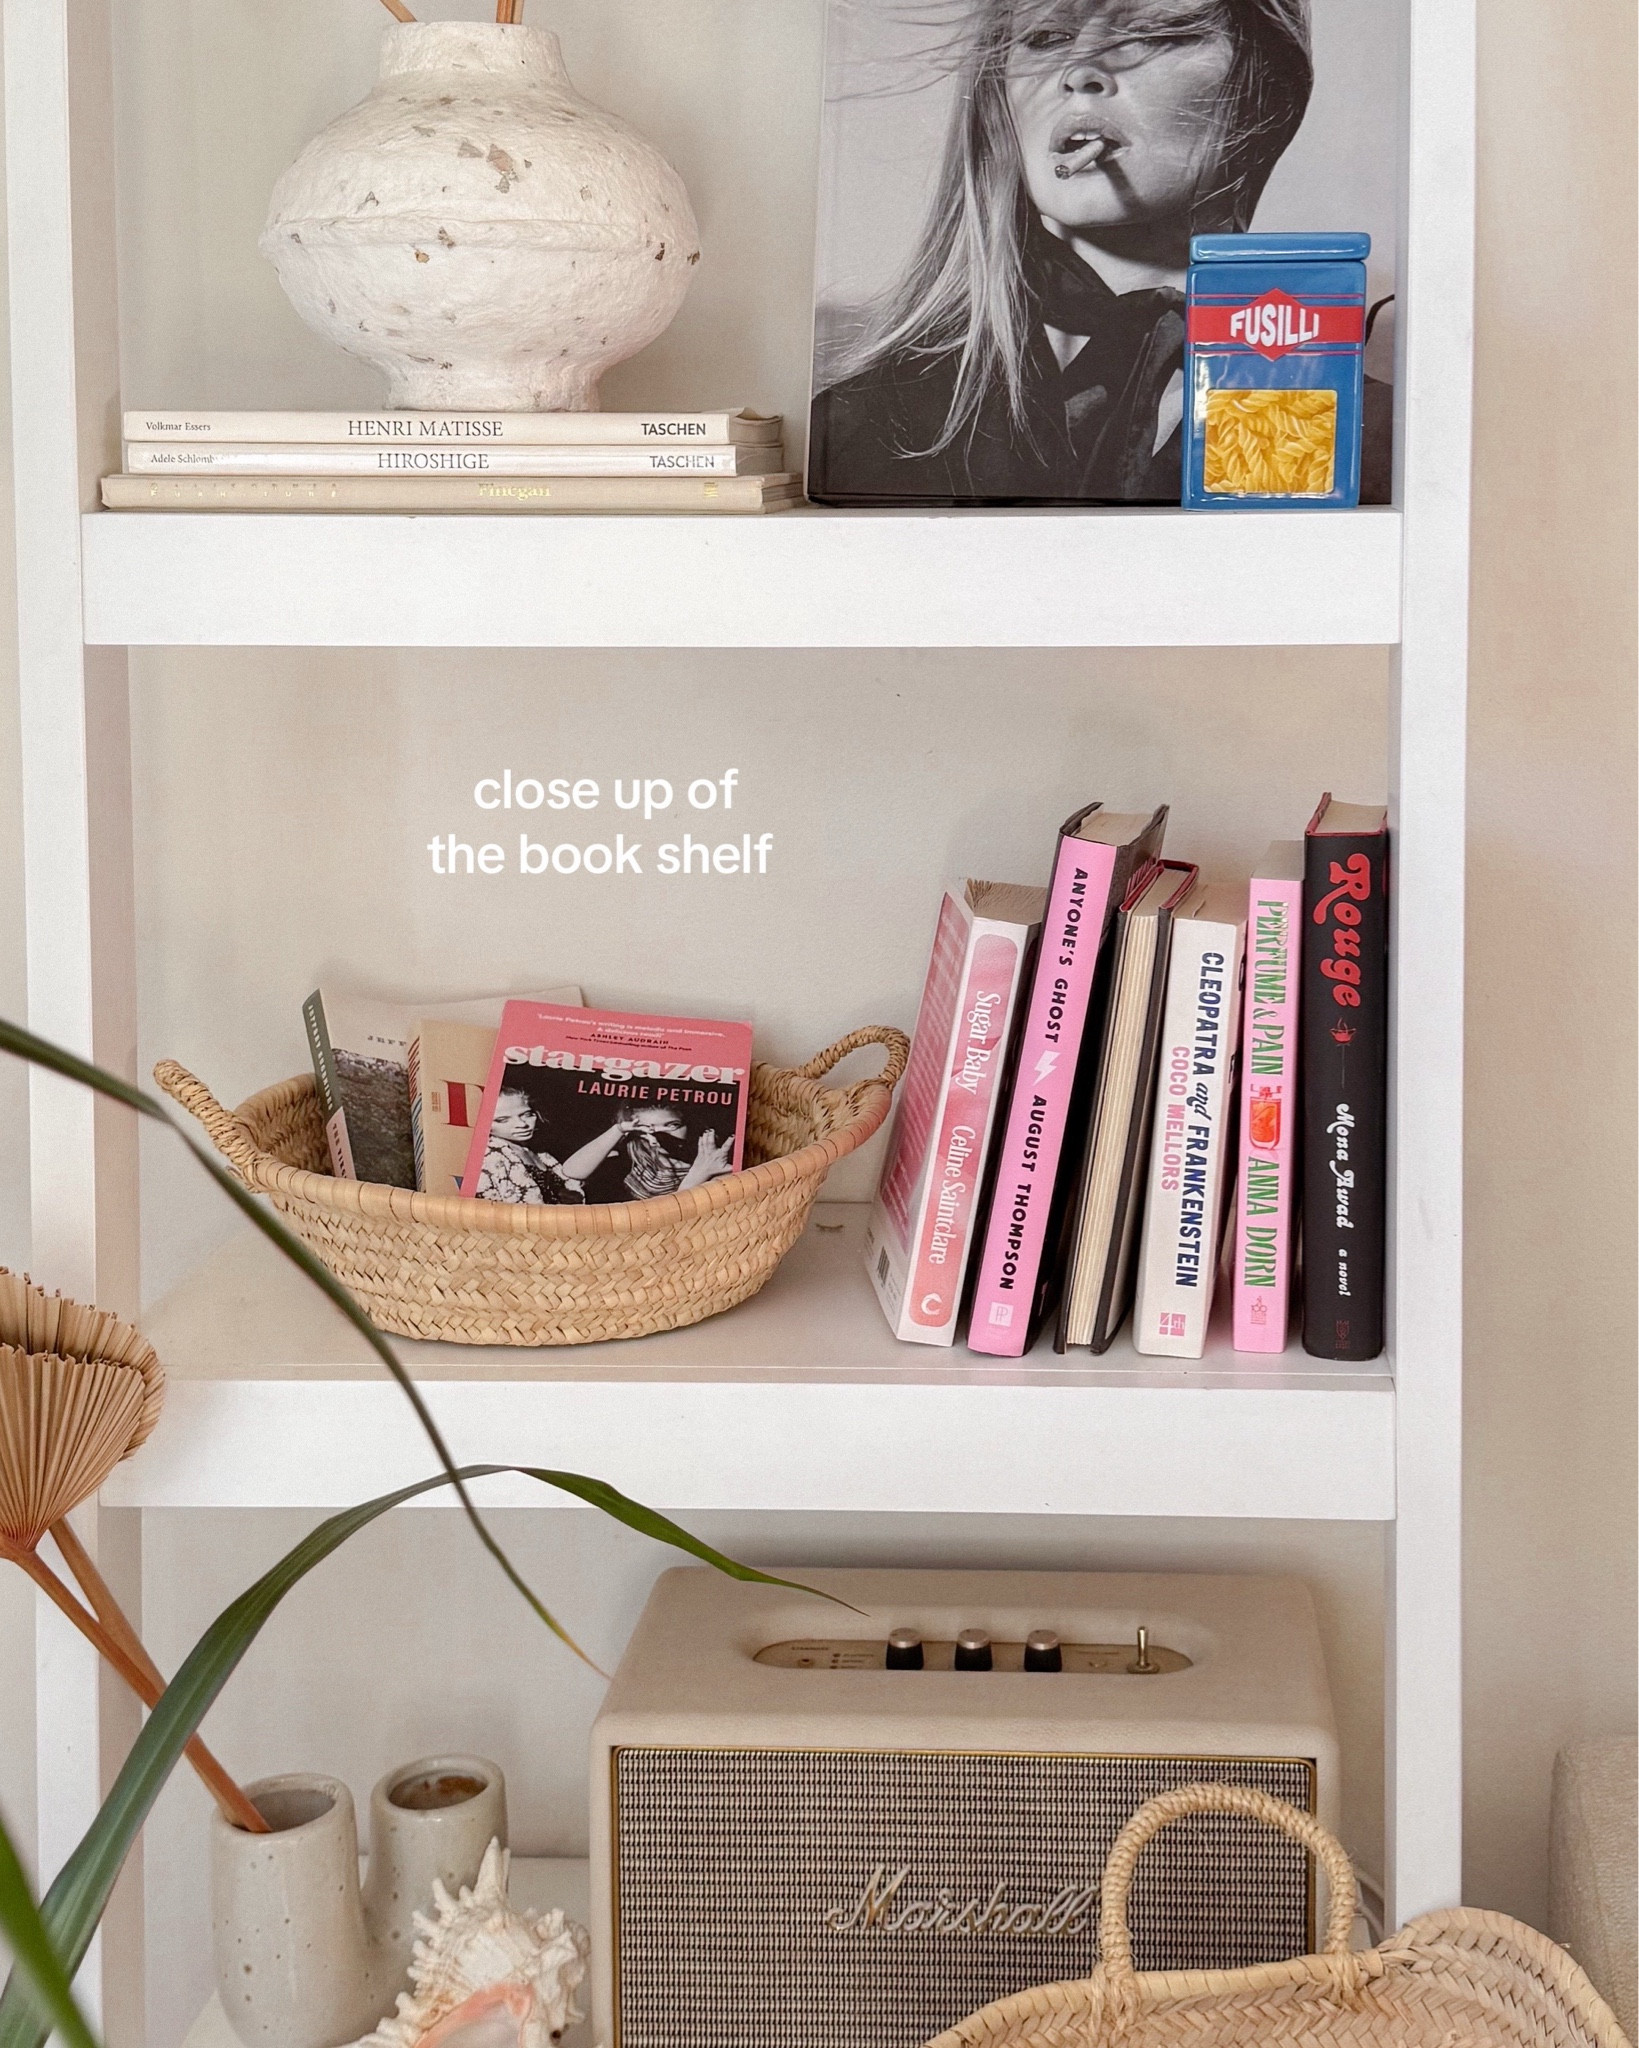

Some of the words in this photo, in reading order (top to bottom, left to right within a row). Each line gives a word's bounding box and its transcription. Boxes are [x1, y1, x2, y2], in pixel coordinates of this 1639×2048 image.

[230, 303, 320, 347] FUSILLI
[146, 421, 182, 431] Volkmar
[185, 422, 211, 431] Essers
[348, 420, 412, 436] HENRI
[418, 420, 503, 437] MATISSE
[641, 422, 706, 436] TASCHEN
[151, 453, 176, 464] Adele
[377, 453, 489, 469] HIROSHIGE
[649, 455, 715, 468] TASCHEN
[1058, 867, 1089, 966] ANYONE'S
[1313, 853, 1371, 1007] Rouge
[1254, 900, 1289, 1005] PERFUME
[1045, 978, 1068, 1043] GHOST
[1192, 952, 1225, 1075] CLEOPATRA
[1253, 1007, 1279, 1020] &
[503, 1045, 746, 1085] stargazer
[955, 1046, 992, 1095] Baby
[1168, 1046, 1190, 1096] COCO
[1251, 1023, 1285, 1076] PAIN
[577, 1080, 649, 1100] LAURIE
[656, 1087, 733, 1106] PETROU
[1186, 1082, 1213, 1121] and
[944, 1125, 976, 1178] Celine
[1021, 1094, 1047, 1172] AUGUST
[1161, 1104, 1186, 1191] MELLORS
[1326, 1103, 1356, 1161] Mona
[1175, 1125, 1210, 1287] FRANKENSTEIN
[1246, 1156, 1280, 1216] ANNA
[1328, 1160, 1355, 1229] Awad
[928, 1178, 966, 1265] Saintclare
[999, 1183, 1032, 1290] THOMPSON
[1244, 1226, 1278, 1287] DORN
[1338, 1248, 1348, 1258] a
[1338, 1262, 1351, 1297] novel
[825, 1863, 1099, 1934] Marshall
